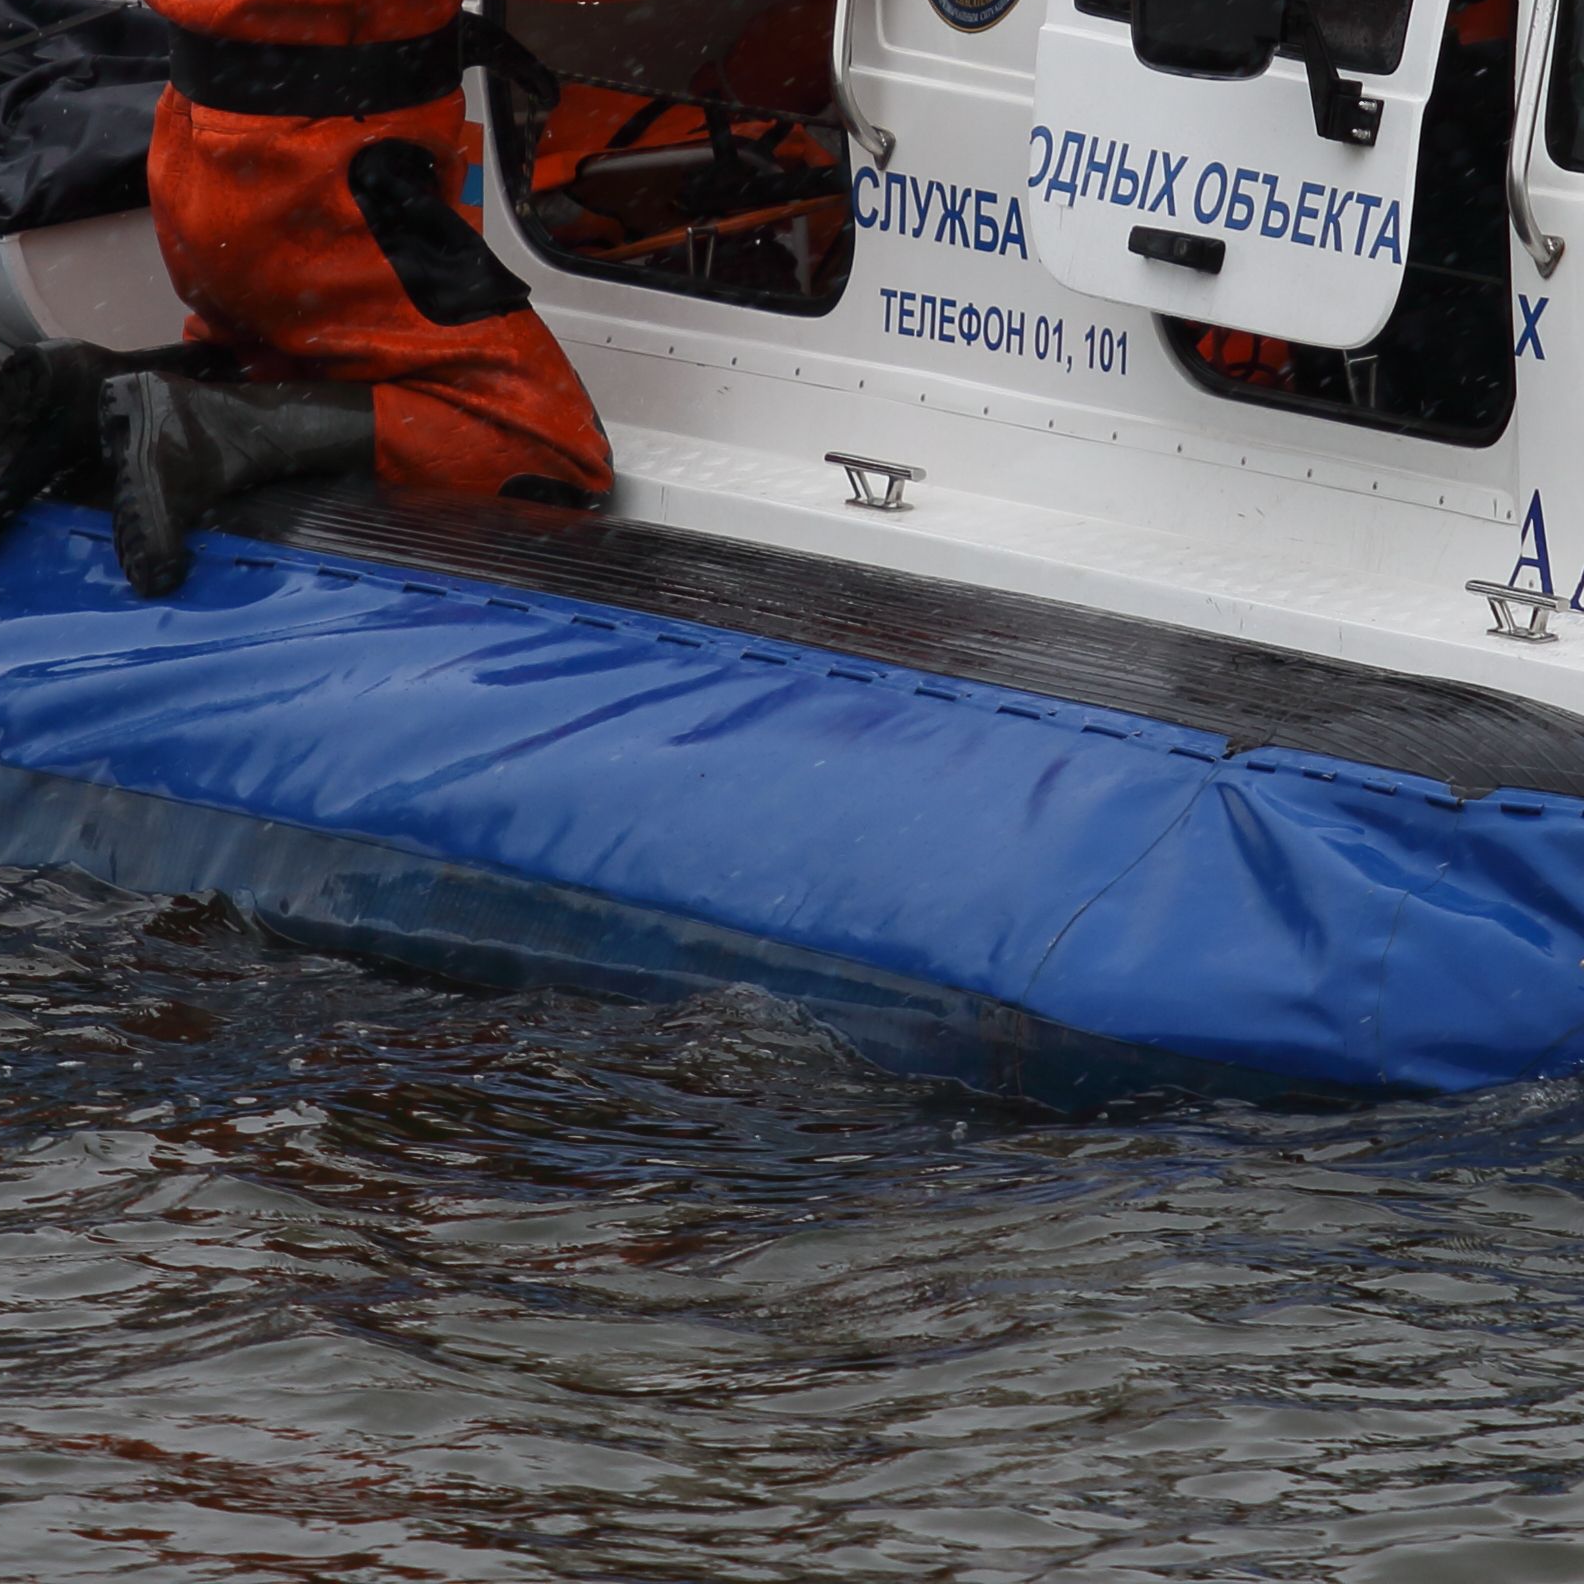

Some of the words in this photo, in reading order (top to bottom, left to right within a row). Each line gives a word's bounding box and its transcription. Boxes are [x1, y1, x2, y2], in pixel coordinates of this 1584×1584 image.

[851, 166, 1029, 260] СЛУЖБА
[1193, 162, 1402, 265] ОБЪЕКТА
[880, 288, 1025, 356] ТЕЛЕФОН
[1035, 316, 1072, 373] 01,
[1084, 324, 1127, 375] 101
